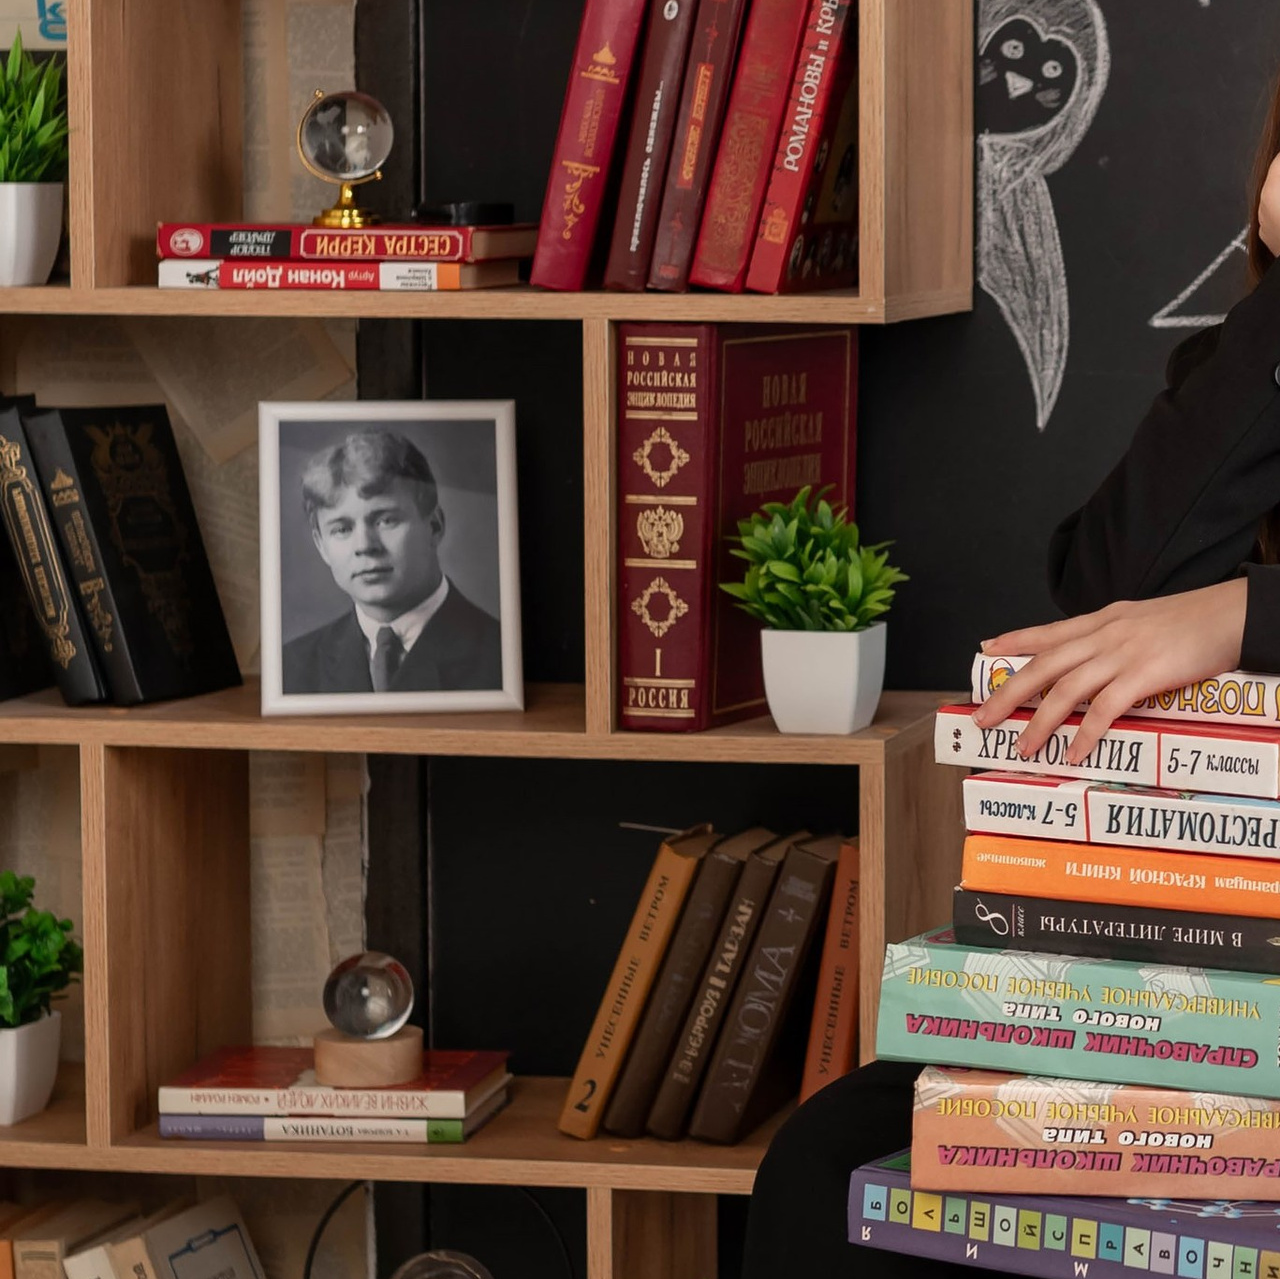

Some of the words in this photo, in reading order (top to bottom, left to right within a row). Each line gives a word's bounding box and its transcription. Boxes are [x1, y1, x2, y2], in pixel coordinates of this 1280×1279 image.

[783, 53, 826, 173] РОМАНОВЫ
[315, 234, 376, 257] КЕРРИ
[383, 235, 451, 256] СЕСТРА
[233, 266, 283, 288] Дойл
[287, 270, 346, 286] Конан
[348, 269, 375, 283] Артур
[627, 350, 697, 368] НОВАЯ
[626, 370, 697, 389] РОССИЙСКАЯ
[762, 372, 808, 409] НОВАЯ
[626, 391, 697, 409] ЭНЦИКЛОПЕДИЯ
[744, 410, 823, 453] РОССИЙСКАЯ
[628, 687, 690, 709] РОССИЯ
[1166, 748, 1201, 775] 5-7
[1206, 750, 1260, 775] классы
[978, 799, 1036, 822] классы
[1040, 800, 1078, 827] 5-7
[975, 850, 1048, 869] животные
[1064, 860, 1122, 880] КНИГИ
[1128, 866, 1206, 889] КРАСНОЙ
[974, 897, 1008, 936] 8
[1039, 915, 1167, 942] ЛИТЕРАТУРЫ
[1171, 926, 1225, 946] МИРЕ
[1231, 930, 1243, 947] В
[818, 964, 847, 1076] УНЕСЕННЫЕ
[839, 878, 860, 951] ВЕТРОМ
[906, 967, 998, 996] ПОСОБИЕ
[573, 1078, 598, 1113] 2
[594, 954, 641, 1060] УНЕСЕННЫЕ
[638, 874, 671, 943] ВЕТРОМ
[1006, 977, 1093, 1004] УЧЕБНОЕ
[1101, 986, 1262, 1021] УНИВЕРСАЛЬНОЕ
[905, 1013, 1075, 1049] ШКОЛЬНИКА
[1084, 1031, 1259, 1069] СПРАВОЧНИК
[936, 1096, 1037, 1119] ПОСОБИЕ
[1044, 1098, 1139, 1124] УЧЕБНОЕ
[281, 1124, 354, 1137] БОТАНИКА
[936, 1143, 1123, 1172] ШКОЛЬНИКА
